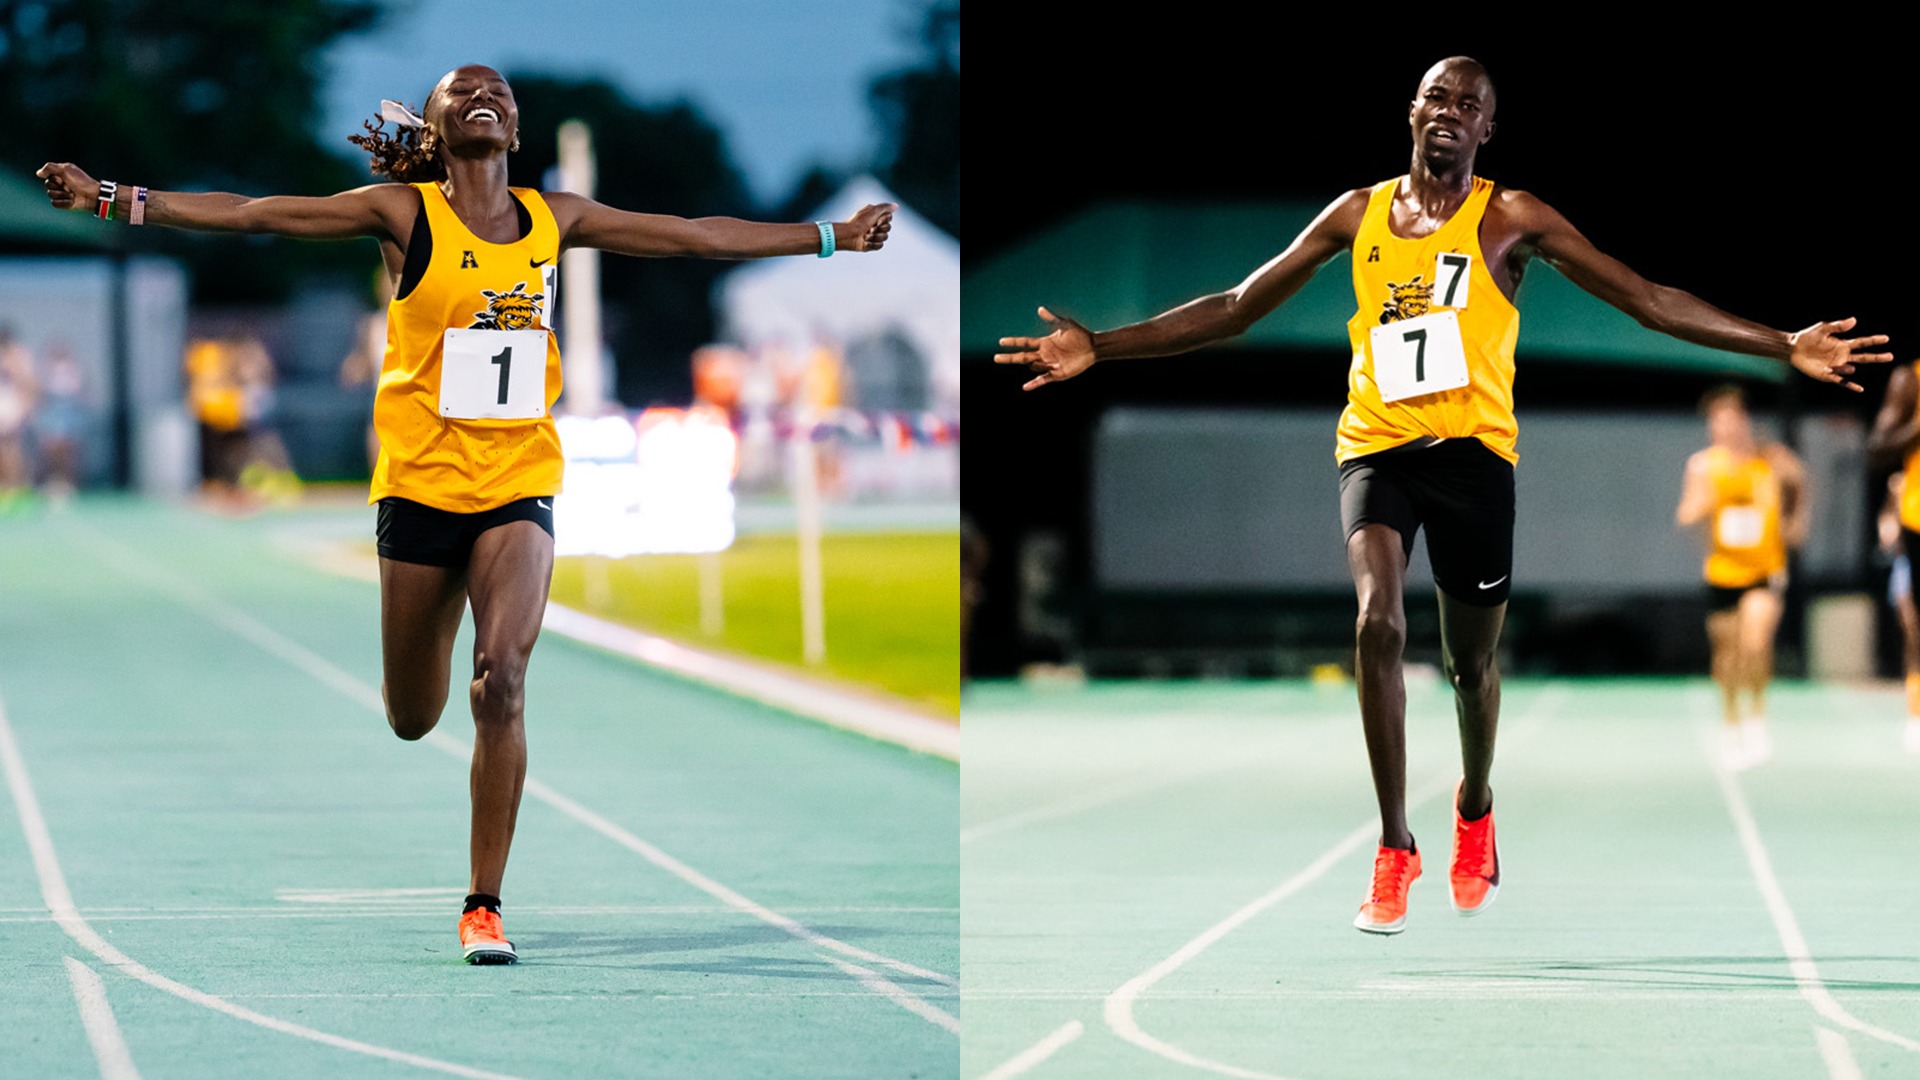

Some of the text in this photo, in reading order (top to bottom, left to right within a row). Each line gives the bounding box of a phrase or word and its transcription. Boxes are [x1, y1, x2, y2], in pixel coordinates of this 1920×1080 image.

[461, 250, 479, 269] A
[1367, 245, 1380, 263] A
[1442, 254, 1468, 307] 7
[546, 267, 556, 326] 1
[491, 346, 513, 405] 1
[1402, 328, 1428, 383] 7
